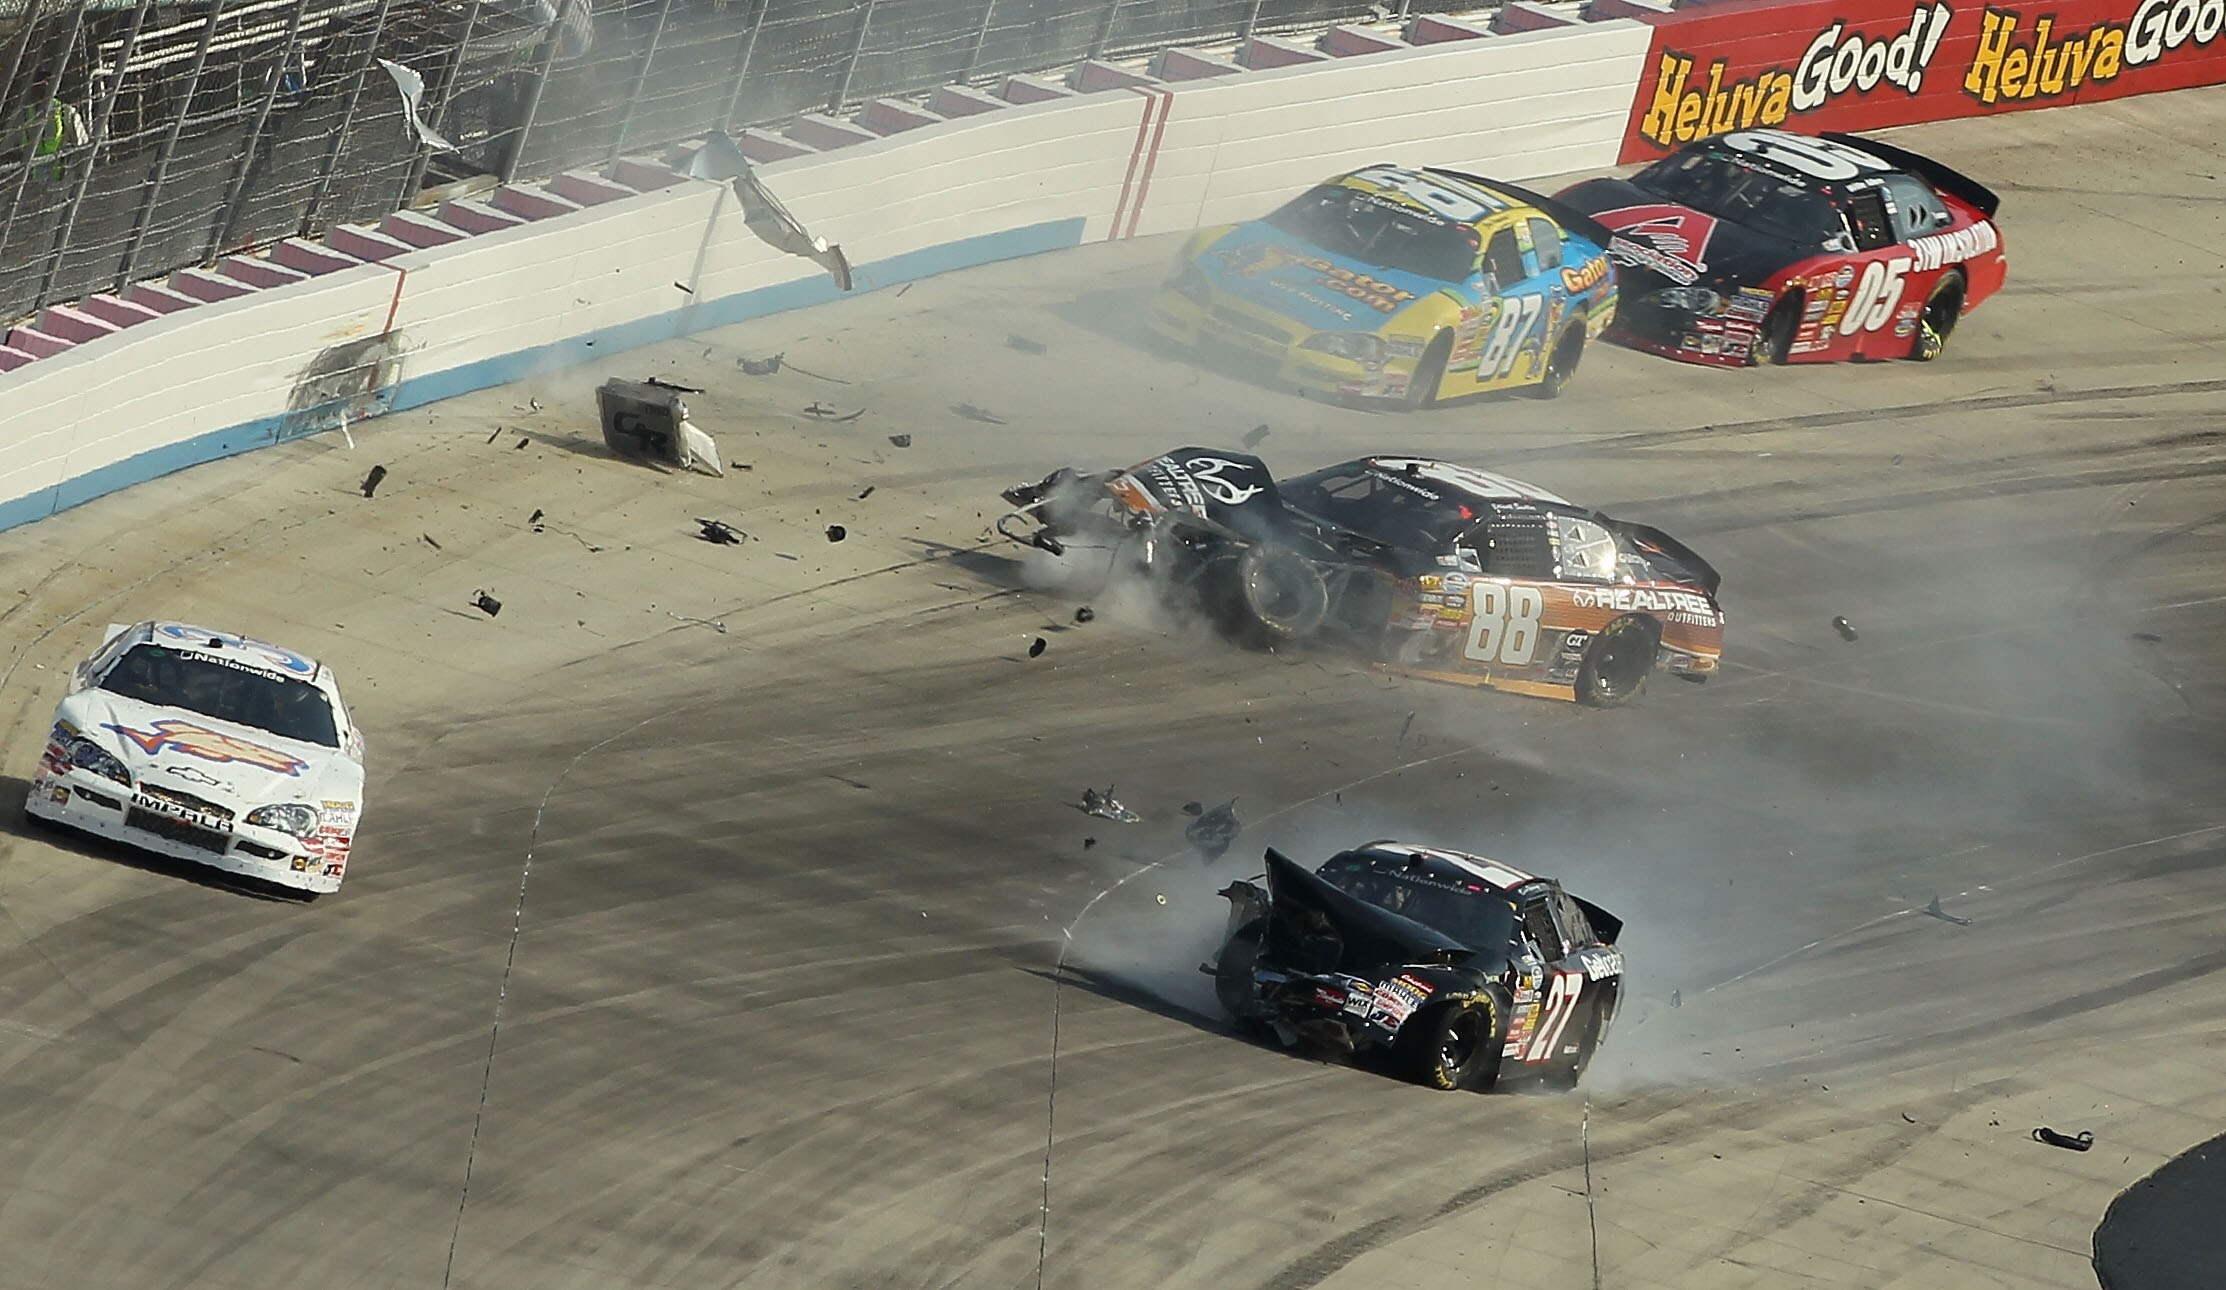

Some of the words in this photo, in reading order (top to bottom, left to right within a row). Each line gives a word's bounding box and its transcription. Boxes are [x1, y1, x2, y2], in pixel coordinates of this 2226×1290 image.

[1641, 53, 1794, 145] Heluva
[1792, 3, 1951, 111] Good!
[1964, 11, 2124, 103] Heluva
[2124, 0, 2226, 64] Goo
[1368, 196, 1445, 226] Nationwide
[1838, 257, 1913, 336] 05
[1476, 294, 1542, 382] 87
[1154, 455, 1208, 520] EALTREE
[1464, 581, 1543, 666] 88
[1595, 588, 1714, 616] REALTREE
[1667, 612, 1718, 628] OUTFITTERS
[194, 652, 285, 683] Nationwide
[131, 792, 234, 833] IMPALA
[1388, 868, 1473, 896] Nationwide
[1348, 996, 1369, 1009] WIX
[1526, 973, 1584, 1062] 27
